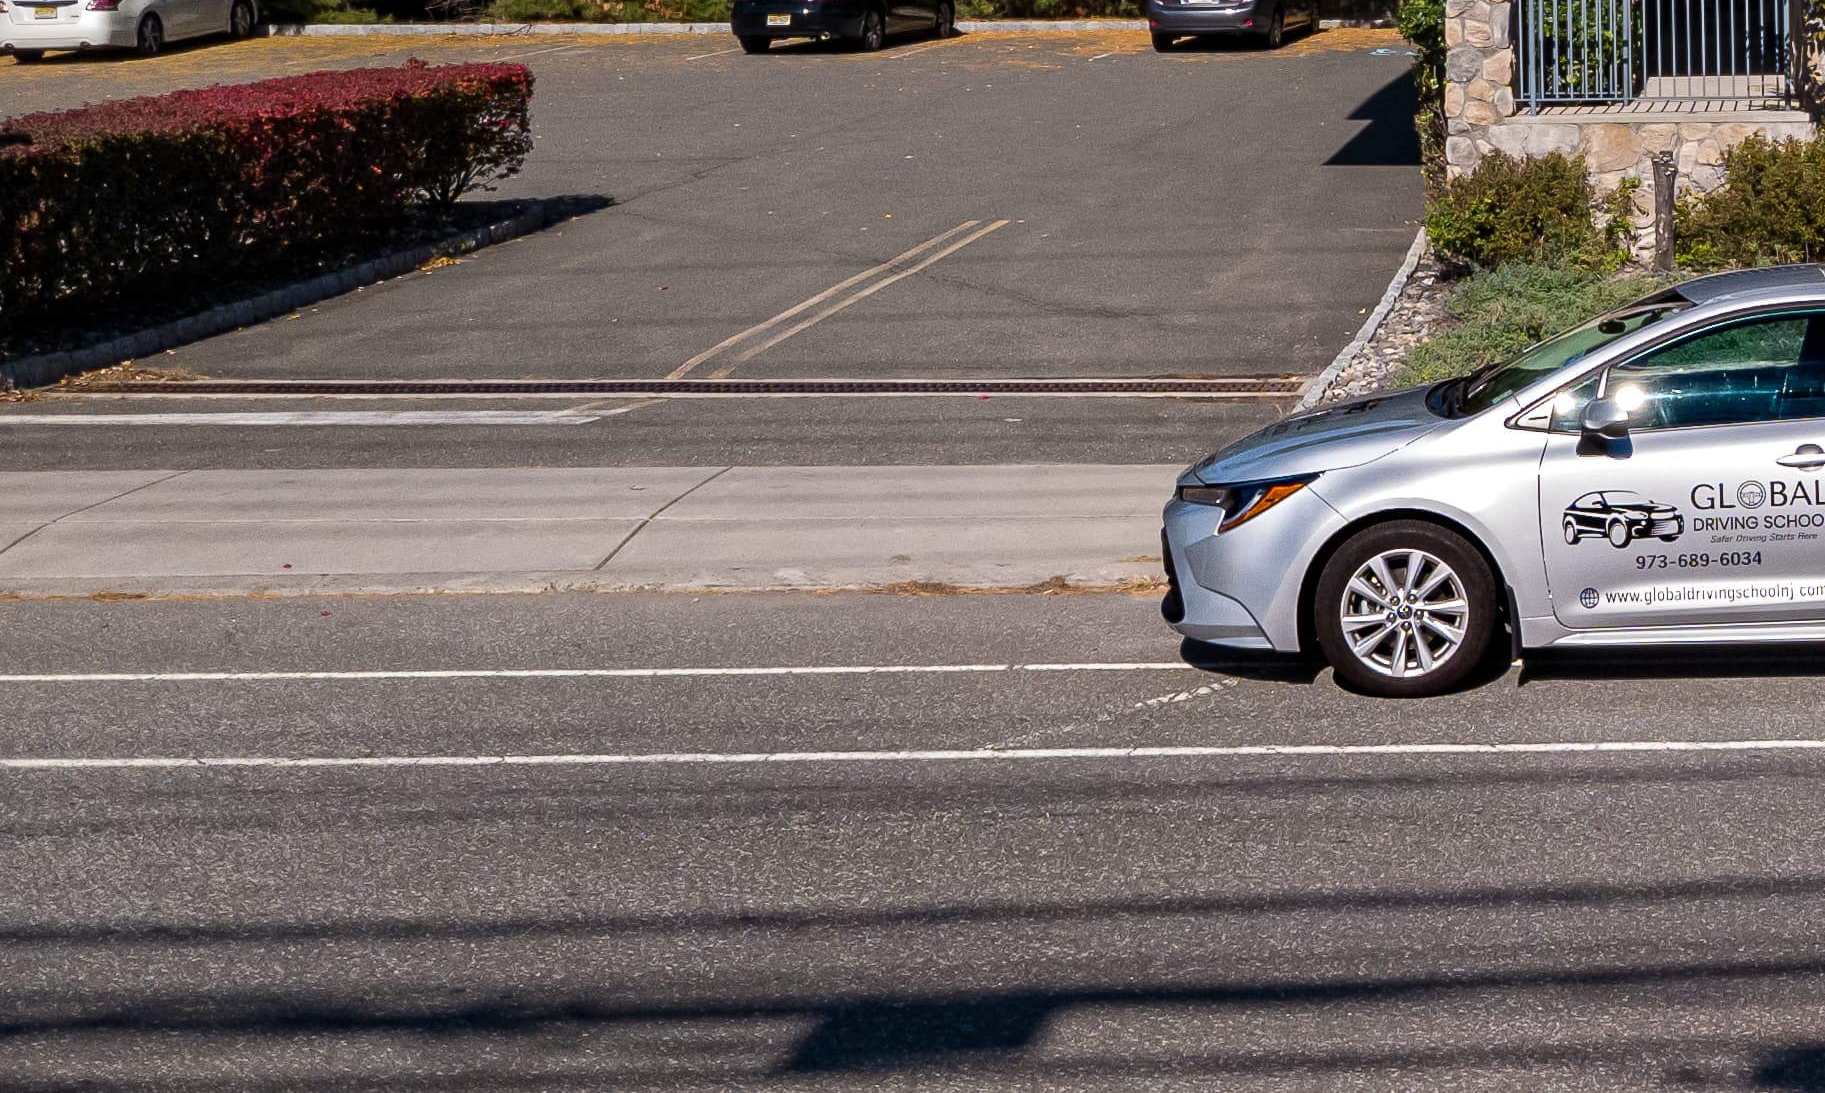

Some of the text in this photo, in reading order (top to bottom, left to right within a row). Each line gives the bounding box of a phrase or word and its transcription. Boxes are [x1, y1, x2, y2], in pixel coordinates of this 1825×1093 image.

[1693, 515, 1759, 532] DRIVING
[1710, 534, 1733, 544] Safer
[1735, 534, 1767, 543] Driving
[1769, 532, 1796, 542] Starts
[1635, 551, 1762, 570] 973-689-6034
